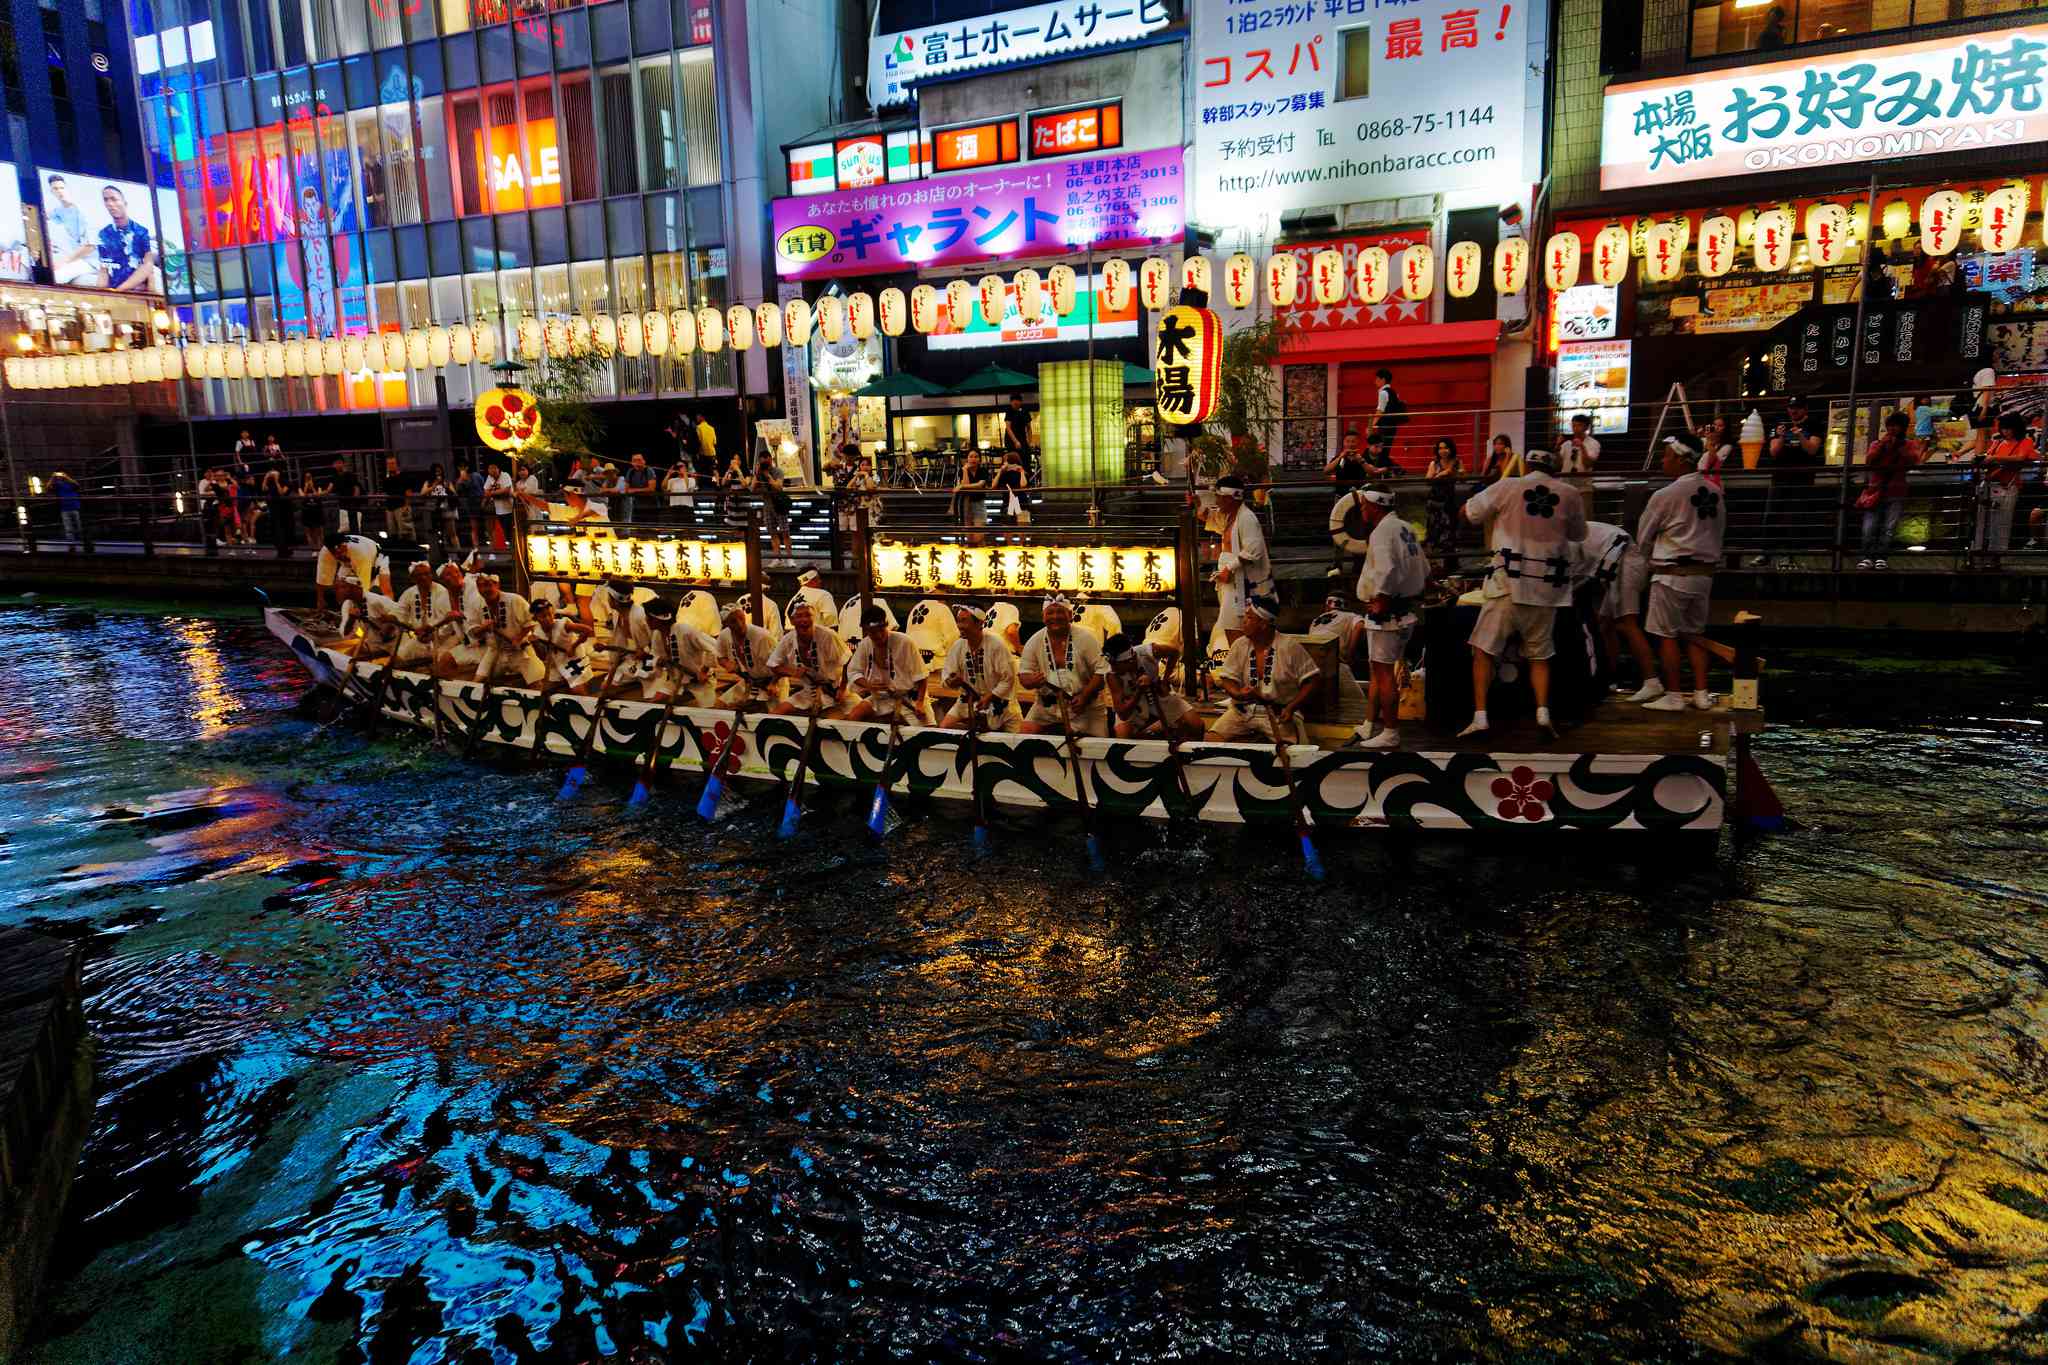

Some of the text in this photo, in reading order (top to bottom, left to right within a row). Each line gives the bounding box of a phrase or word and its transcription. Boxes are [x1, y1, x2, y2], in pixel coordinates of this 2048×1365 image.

[1204, 34, 1322, 88] コスパ
[1202, 90, 1326, 125] 幹部スタッフ募集
[1633, 90, 1696, 137] 本場
[954, 135, 979, 161] 酒
[1033, 117, 1098, 149] たばこ
[1219, 131, 1296, 162] 予約受付
[1357, 105, 1494, 142] 0868-75-1144
[1649, 123, 1714, 171] 大阪
[1744, 119, 2027, 171] OKONOMIYAKI
[483, 146, 561, 192] SALE
[1219, 144, 1496, 194] http://www.nihonbaracc.com
[786, 231, 826, 255] 賃貸
[839, 196, 1060, 261] ギャラント
[1156, 314, 1196, 415] 木場
[677, 543, 691, 576] 木場
[904, 550, 923, 586] 木場
[928, 546, 942, 583] 木場
[957, 550, 973, 587] 木場
[988, 549, 1007, 587] 木場
[1017, 550, 1036, 588] 木場
[1046, 550, 1061, 590] 木場
[1079, 551, 1095, 588] 木場
[1111, 552, 1125, 590] 木場
[1144, 551, 1162, 590] 木場
